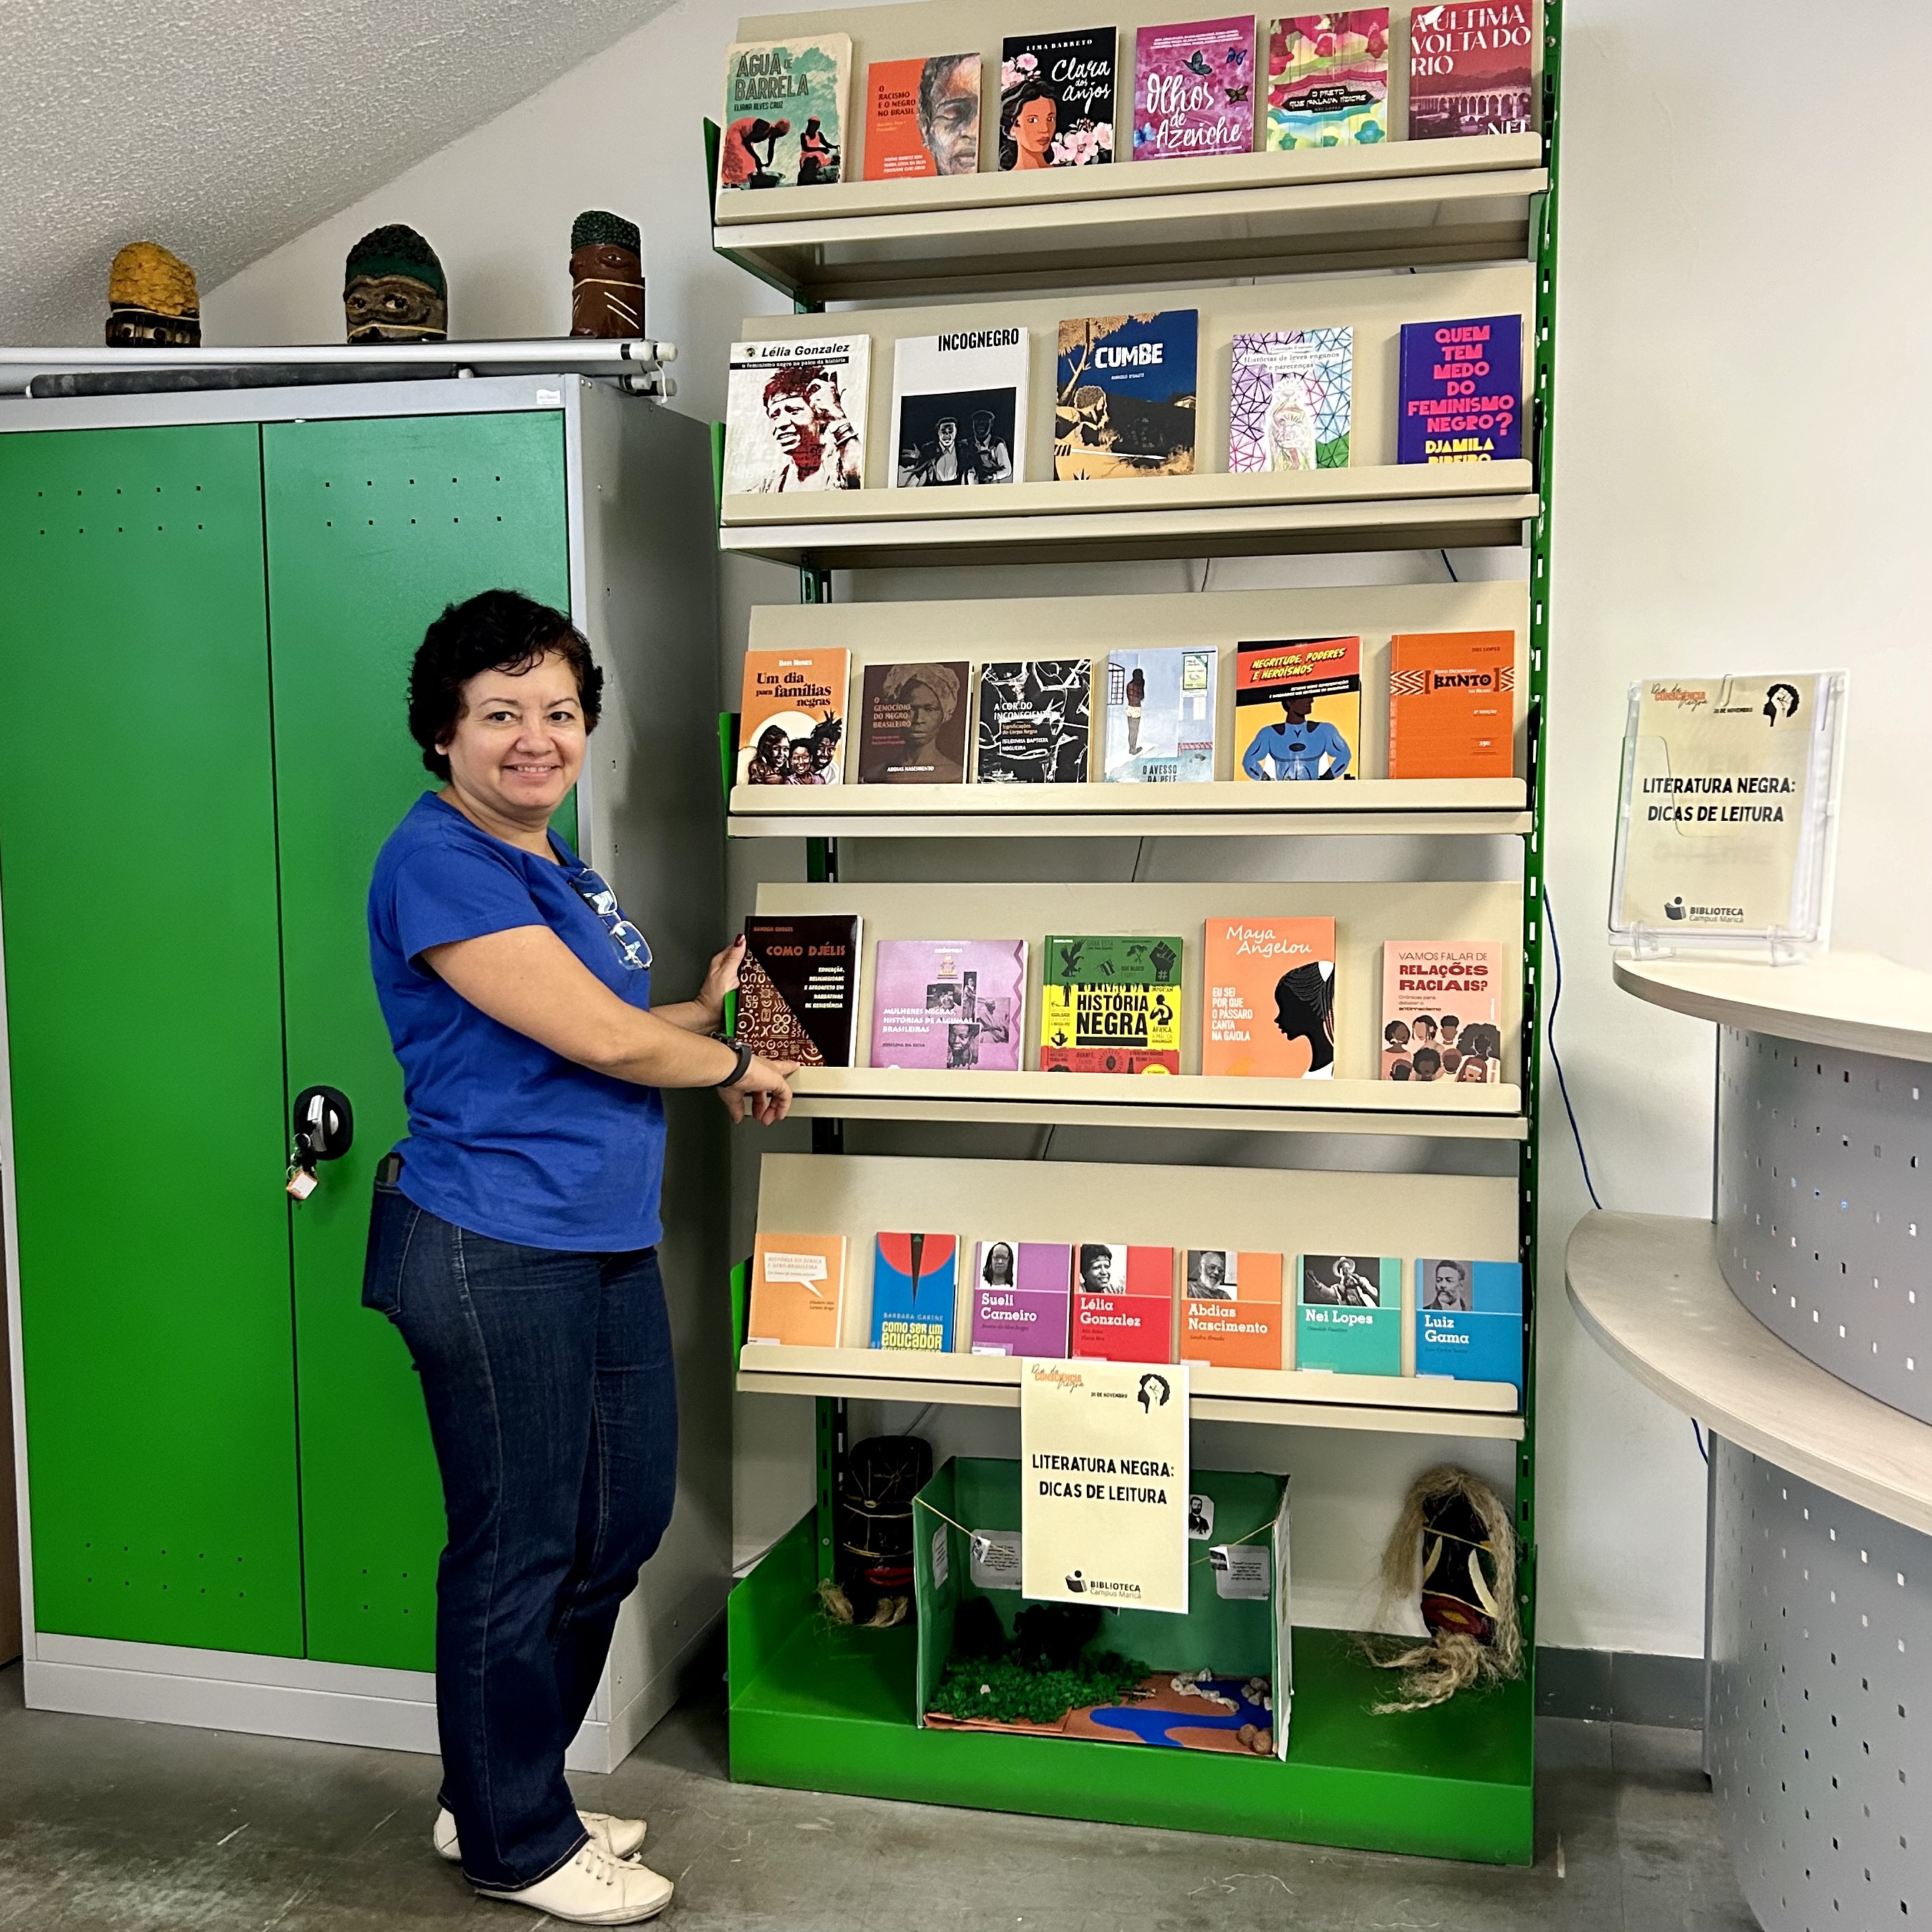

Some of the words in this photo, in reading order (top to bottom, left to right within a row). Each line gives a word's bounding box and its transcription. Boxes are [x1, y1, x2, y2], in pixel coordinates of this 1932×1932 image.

[1412, 14, 1427, 32] A
[1051, 39, 1093, 49] BARRETO
[1411, 31, 1487, 54] VOLTA
[1493, 26, 1531, 48] DO
[736, 51, 782, 77] ÁGUA
[784, 59, 792, 69] DE
[1051, 57, 1110, 82] Clara
[1411, 55, 1454, 77] RIO
[735, 74, 809, 101] BARRELA
[1147, 73, 1214, 114] Olhos
[879, 92, 910, 100] RACISMO
[770, 101, 783, 109] CRUZ
[1170, 108, 1186, 128] de
[1156, 117, 1242, 149] Azeviche
[938, 328, 1019, 352] INCOGNEGRO
[1435, 325, 1490, 343] QUEM
[762, 347, 790, 358] Lélia
[795, 343, 849, 355] Gonzalez
[1095, 343, 1163, 368] CUMBE
[1441, 344, 1483, 361] TEM
[1244, 355, 1277, 363] Histórias
[1434, 361, 1489, 379] MEDO
[1447, 380, 1475, 396] DO
[1408, 395, 1514, 416] FEMINISMO
[1427, 412, 1513, 436] NEGRO?
[1425, 438, 1494, 453] DJAMILA
[1306, 648, 1346, 662] PODERES
[756, 673, 779, 684] Um
[784, 672, 804, 683] dia
[1253, 671, 1260, 681] E
[1261, 664, 1314, 679] HEROÍSMOS
[1434, 674, 1492, 689] BANTO
[774, 684, 832, 697] famílias
[1655, 690, 1706, 701] CONSCIÊNCIA
[797, 698, 831, 709] negras
[1143, 765, 1147, 774] O
[1149, 764, 1177, 774] AVESSO
[1643, 778, 1733, 794] LITERATURA
[1738, 778, 1795, 794] NEGRA:
[1648, 806, 1693, 821] DICAS
[1697, 806, 1717, 821] DE
[1721, 807, 1783, 822] LEITURA
[1689, 915, 1719, 923] Campus
[1721, 915, 1744, 923] Maricá
[1690, 907, 1743, 916] BIBLIOTECA
[1226, 925, 1276, 943] Maya
[767, 946, 803, 956] COMO
[808, 942, 845, 956] DJÉLIS
[1236, 940, 1312, 957] Angelou
[1399, 962, 1488, 978] RELAÇÕES
[1213, 987, 1222, 997] EU
[1223, 987, 1236, 997] SEI
[1399, 980, 1487, 991] RACIAIS?
[1078, 992, 1148, 1011] HISTÓRIA
[1213, 997, 1227, 1007] POR
[1229, 997, 1243, 1007] QUE
[884, 1015, 923, 1024] HISTÓRIAS
[1212, 1009, 1217, 1019] O
[1219, 1007, 1253, 1019] PÁSSARO
[1077, 1012, 1148, 1035] NEGRA
[1212, 1020, 1235, 1030] CANTA
[1212, 1031, 1222, 1040] NA
[1223, 1031, 1251, 1041] GAIOLA
[982, 1293, 1014, 1306] Sueli
[1081, 1297, 1113, 1311] Lélia
[981, 1307, 1038, 1321] Carneiro
[1188, 1303, 1236, 1317] Abdias
[1306, 1309, 1329, 1322] Nei
[1333, 1310, 1373, 1326] Lopes
[1080, 1312, 1140, 1326] Gonzalez
[1188, 1318, 1268, 1334] Nascimento
[1425, 1315, 1454, 1328] Luiz
[1425, 1329, 1469, 1344] Gama
[1035, 1371, 1082, 1383] CONSCIÊNCIA
[1032, 1454, 1116, 1474] LITERATURA
[1120, 1459, 1174, 1477] NEGRA:
[1040, 1481, 1082, 1498] DICAS
[1086, 1484, 1105, 1499] DE
[1109, 1486, 1167, 1504] LEITURA
[1090, 1580, 1141, 1592] BIBLIOTECA
[1090, 1588, 1117, 1598] Campus
